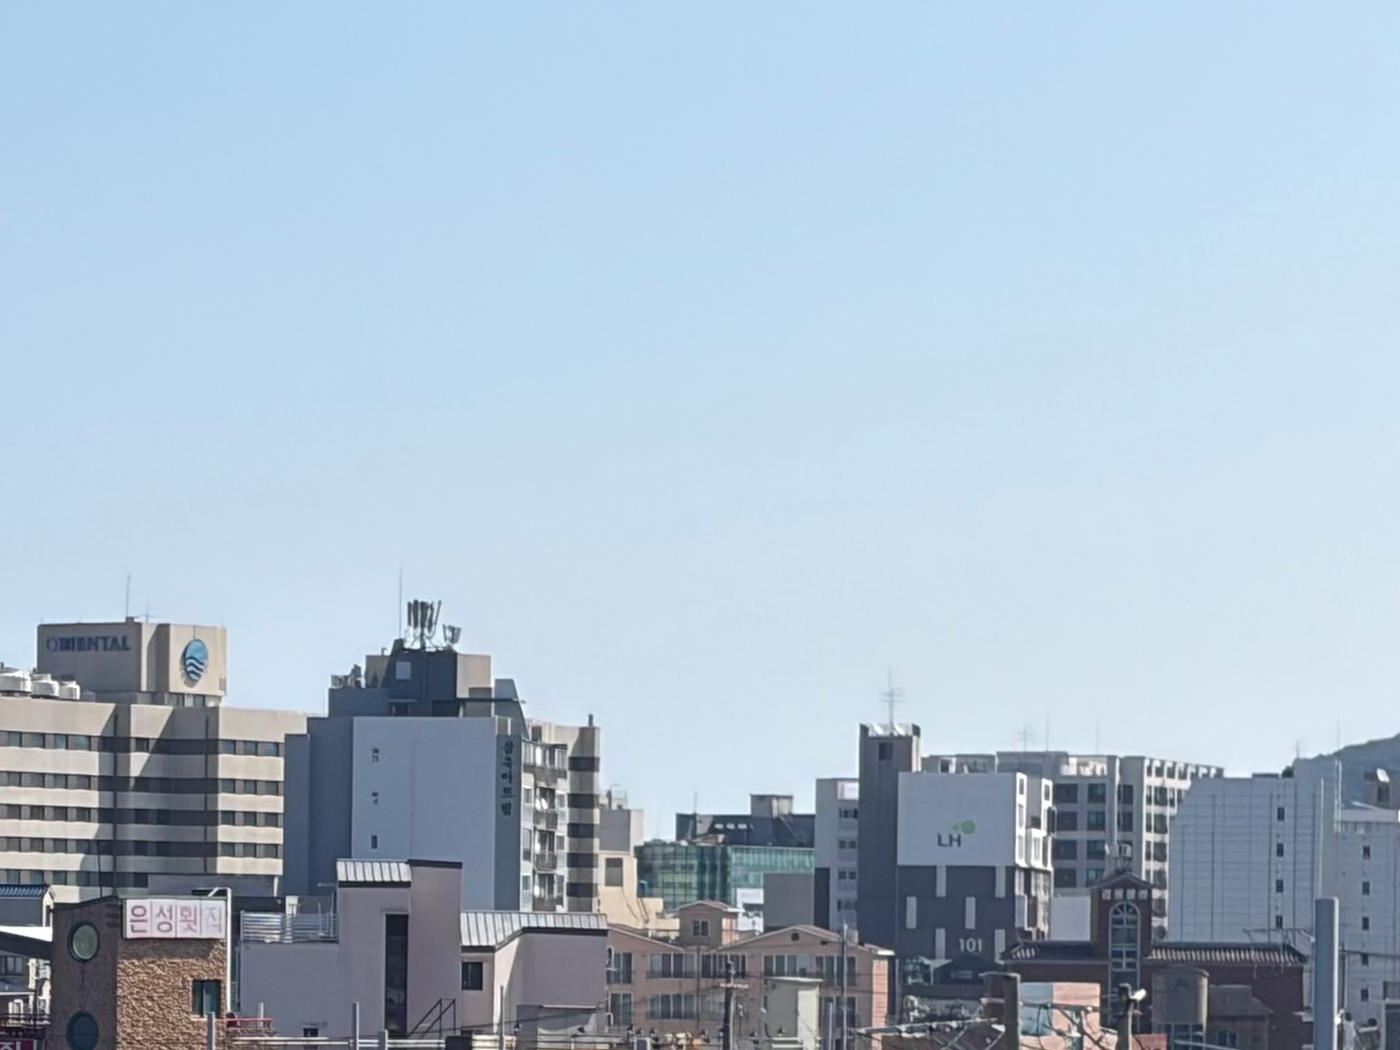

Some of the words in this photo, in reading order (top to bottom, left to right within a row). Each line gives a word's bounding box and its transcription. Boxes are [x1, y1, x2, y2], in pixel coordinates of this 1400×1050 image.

[937, 833, 962, 848] LH
[129, 905, 224, 933] 은성횟집
[959, 938, 982, 953] 101
